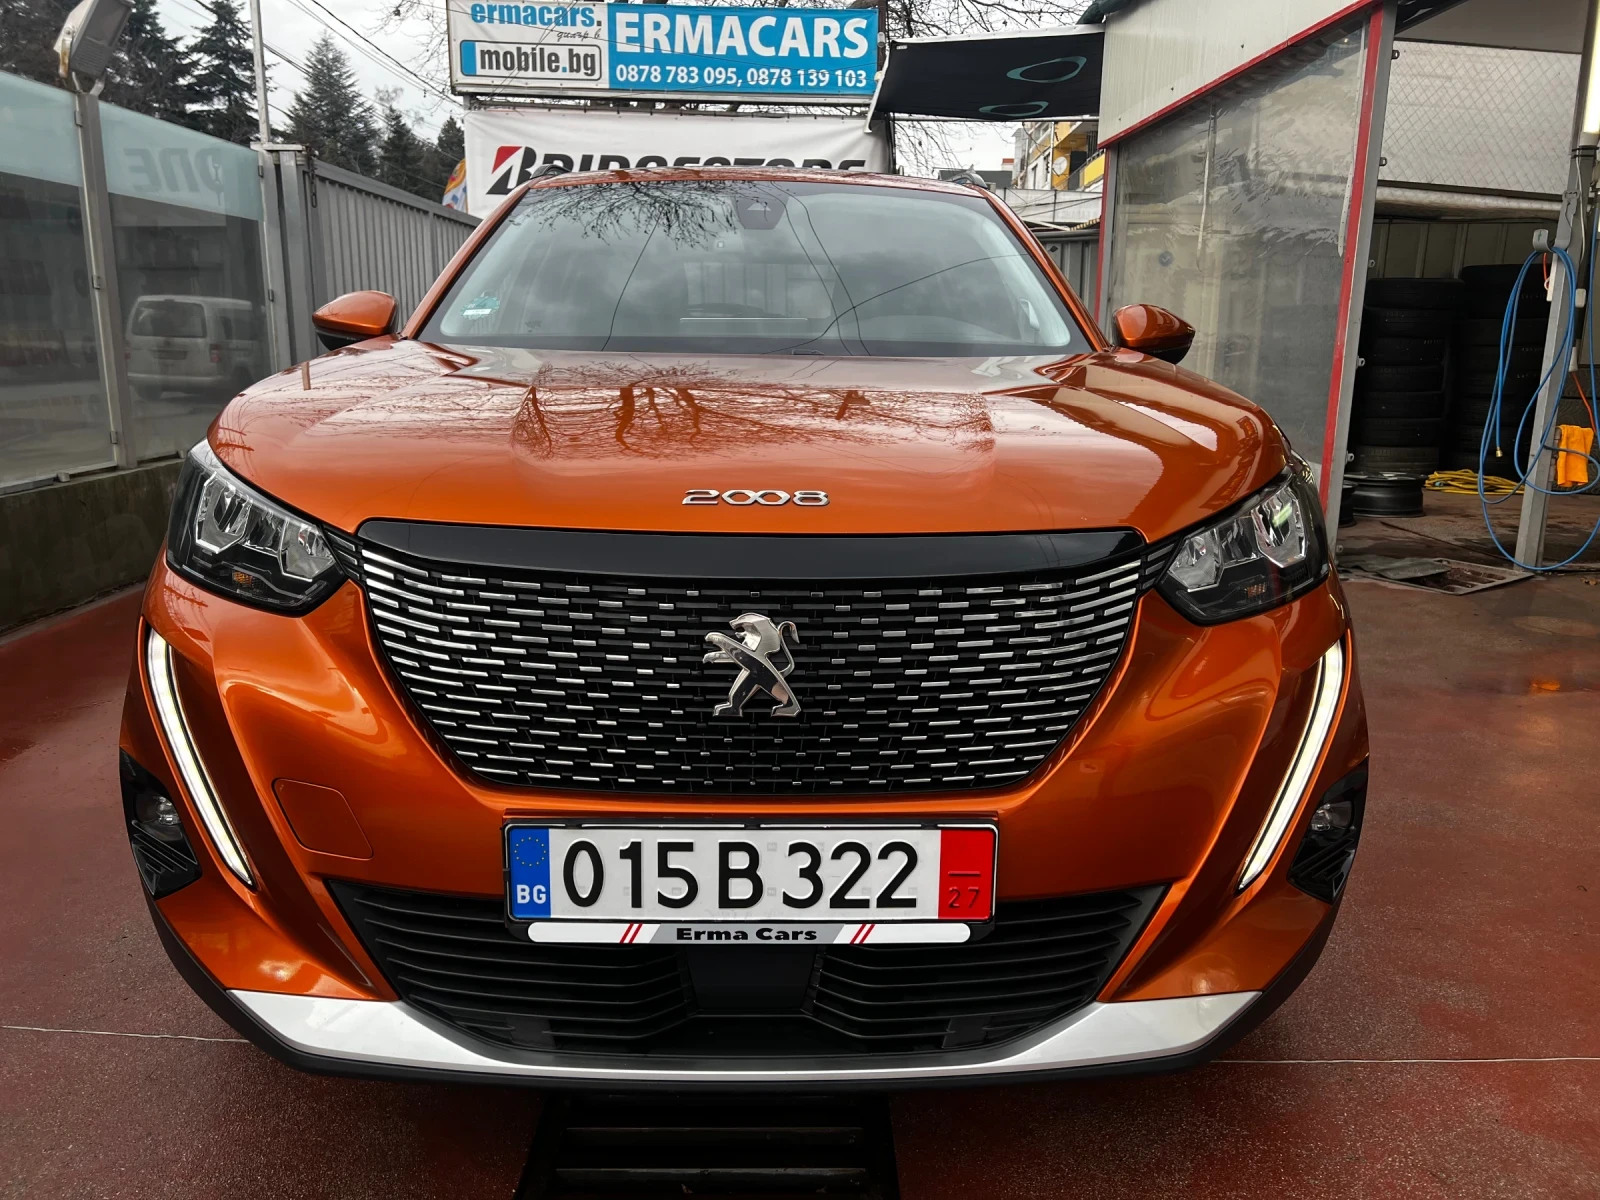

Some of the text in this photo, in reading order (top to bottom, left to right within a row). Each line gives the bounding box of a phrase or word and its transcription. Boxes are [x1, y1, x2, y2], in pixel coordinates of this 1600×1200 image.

[616, 12, 868, 58] ERMACARS
[480, 47, 596, 77] mobile.bg
[616, 64, 867, 87] 0878 783 095, 0878 139 103
[682, 489, 830, 506] 2008
[563, 840, 918, 909] 015 B 322
[516, 884, 547, 904] BG
[948, 886, 981, 909] 27
[676, 927, 818, 941] Erma Cars
